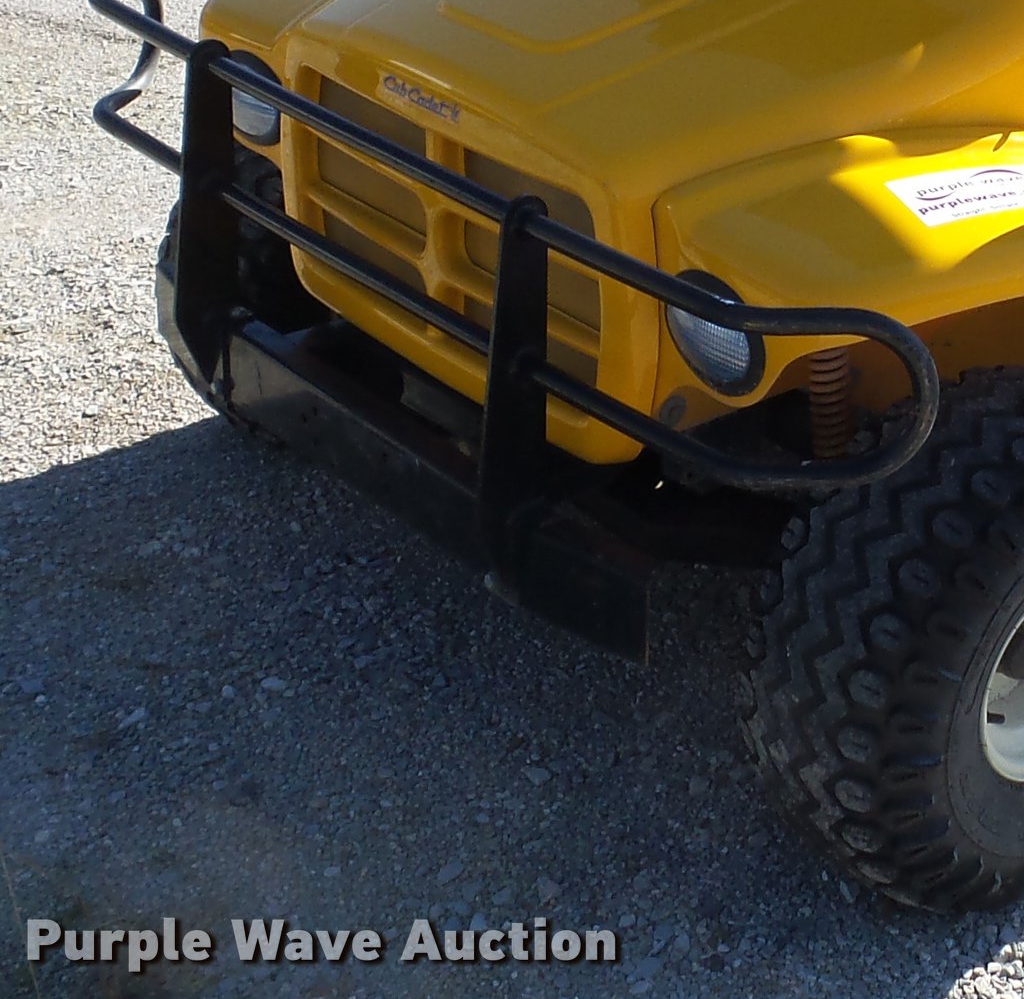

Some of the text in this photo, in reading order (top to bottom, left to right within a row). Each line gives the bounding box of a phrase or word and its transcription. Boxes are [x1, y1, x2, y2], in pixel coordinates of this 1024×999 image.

[384, 75, 453, 119] Cub Cadet
[916, 174, 1024, 197] purple wave
